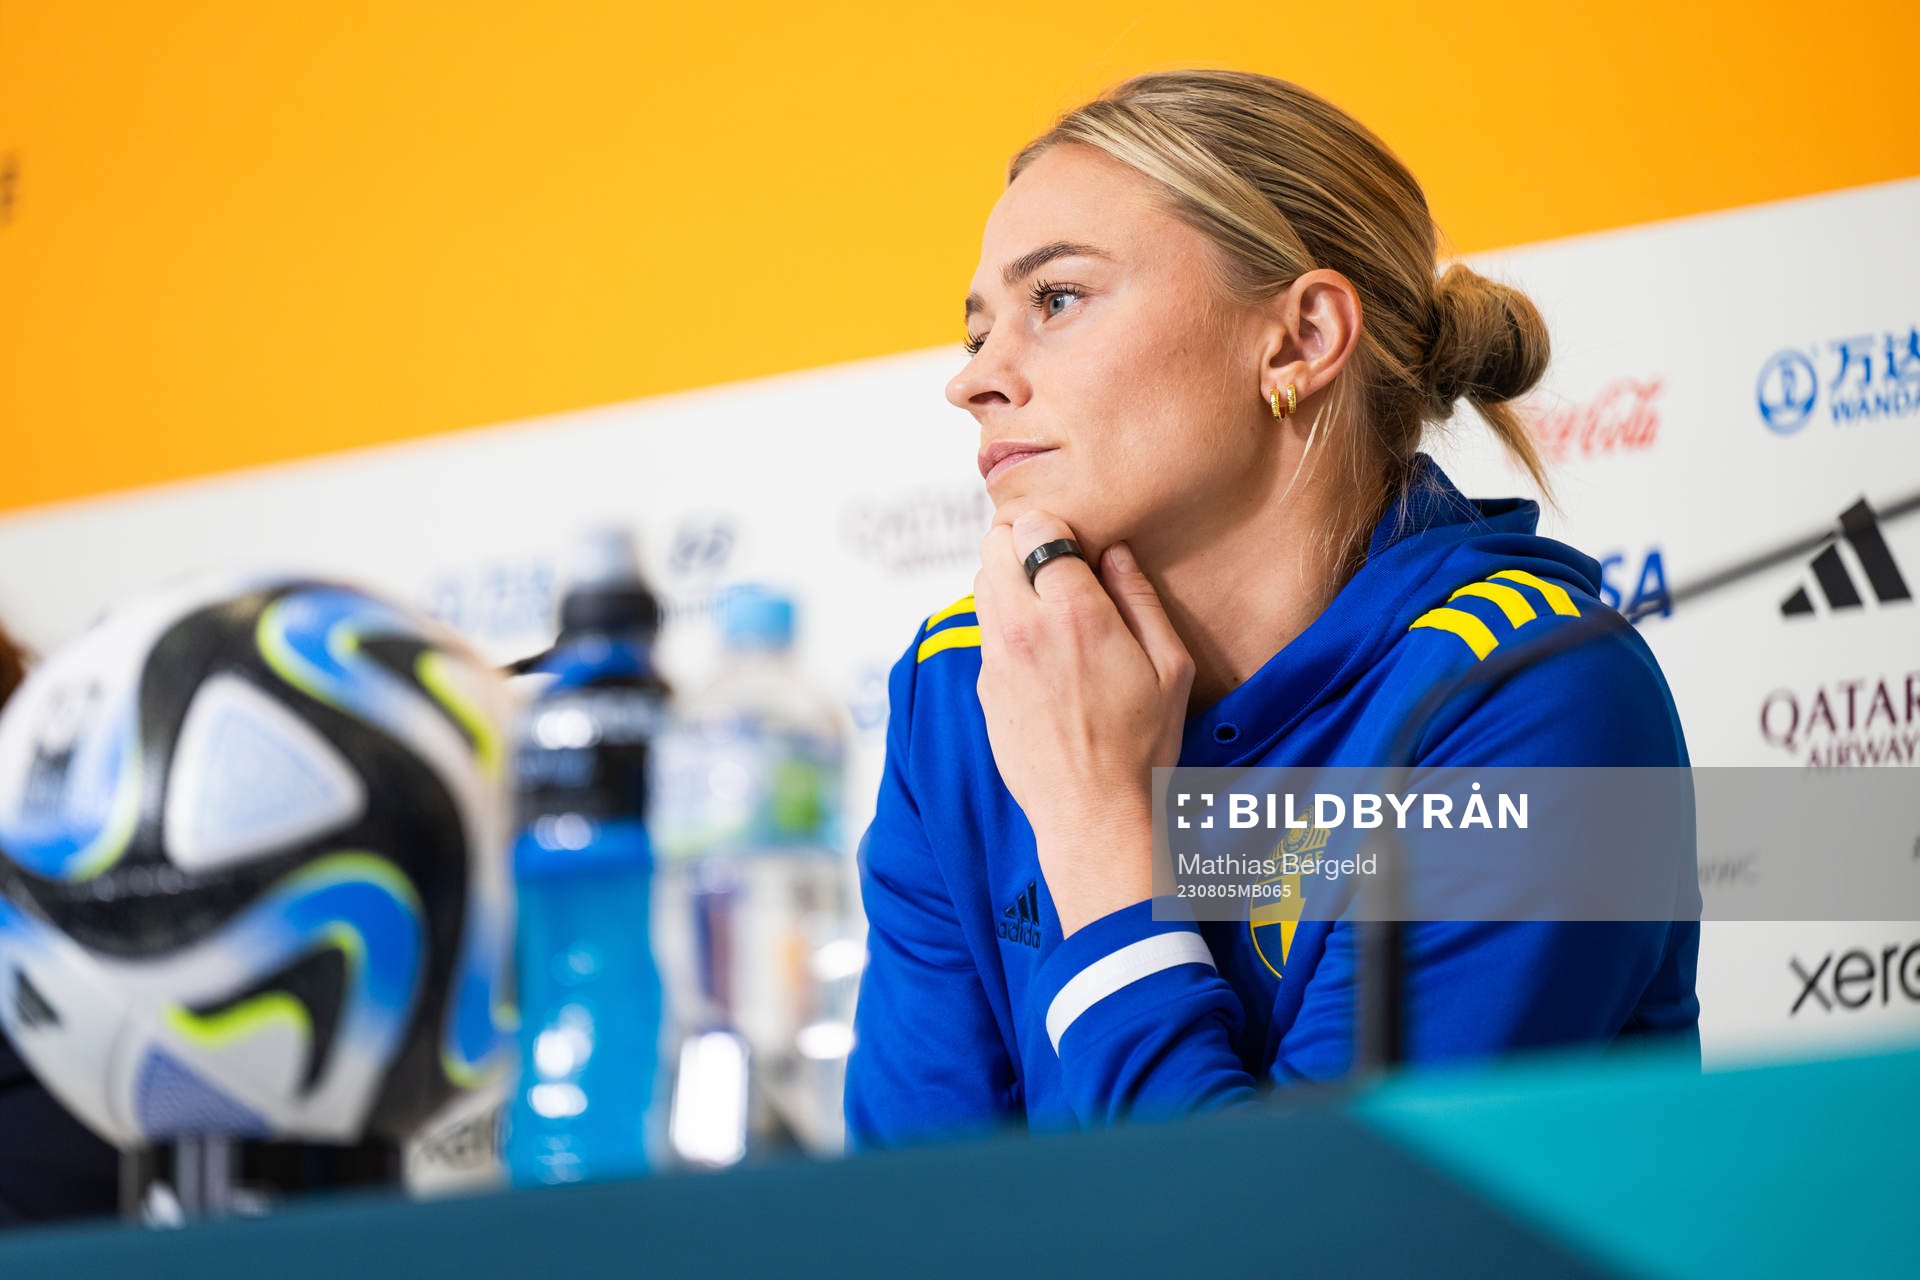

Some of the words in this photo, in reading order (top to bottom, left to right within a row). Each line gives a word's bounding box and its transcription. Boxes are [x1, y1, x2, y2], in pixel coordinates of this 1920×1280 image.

[1601, 550, 1671, 624] SA
[1806, 735, 1920, 773] AIRWAY
[1789, 941, 1920, 1017] xero
